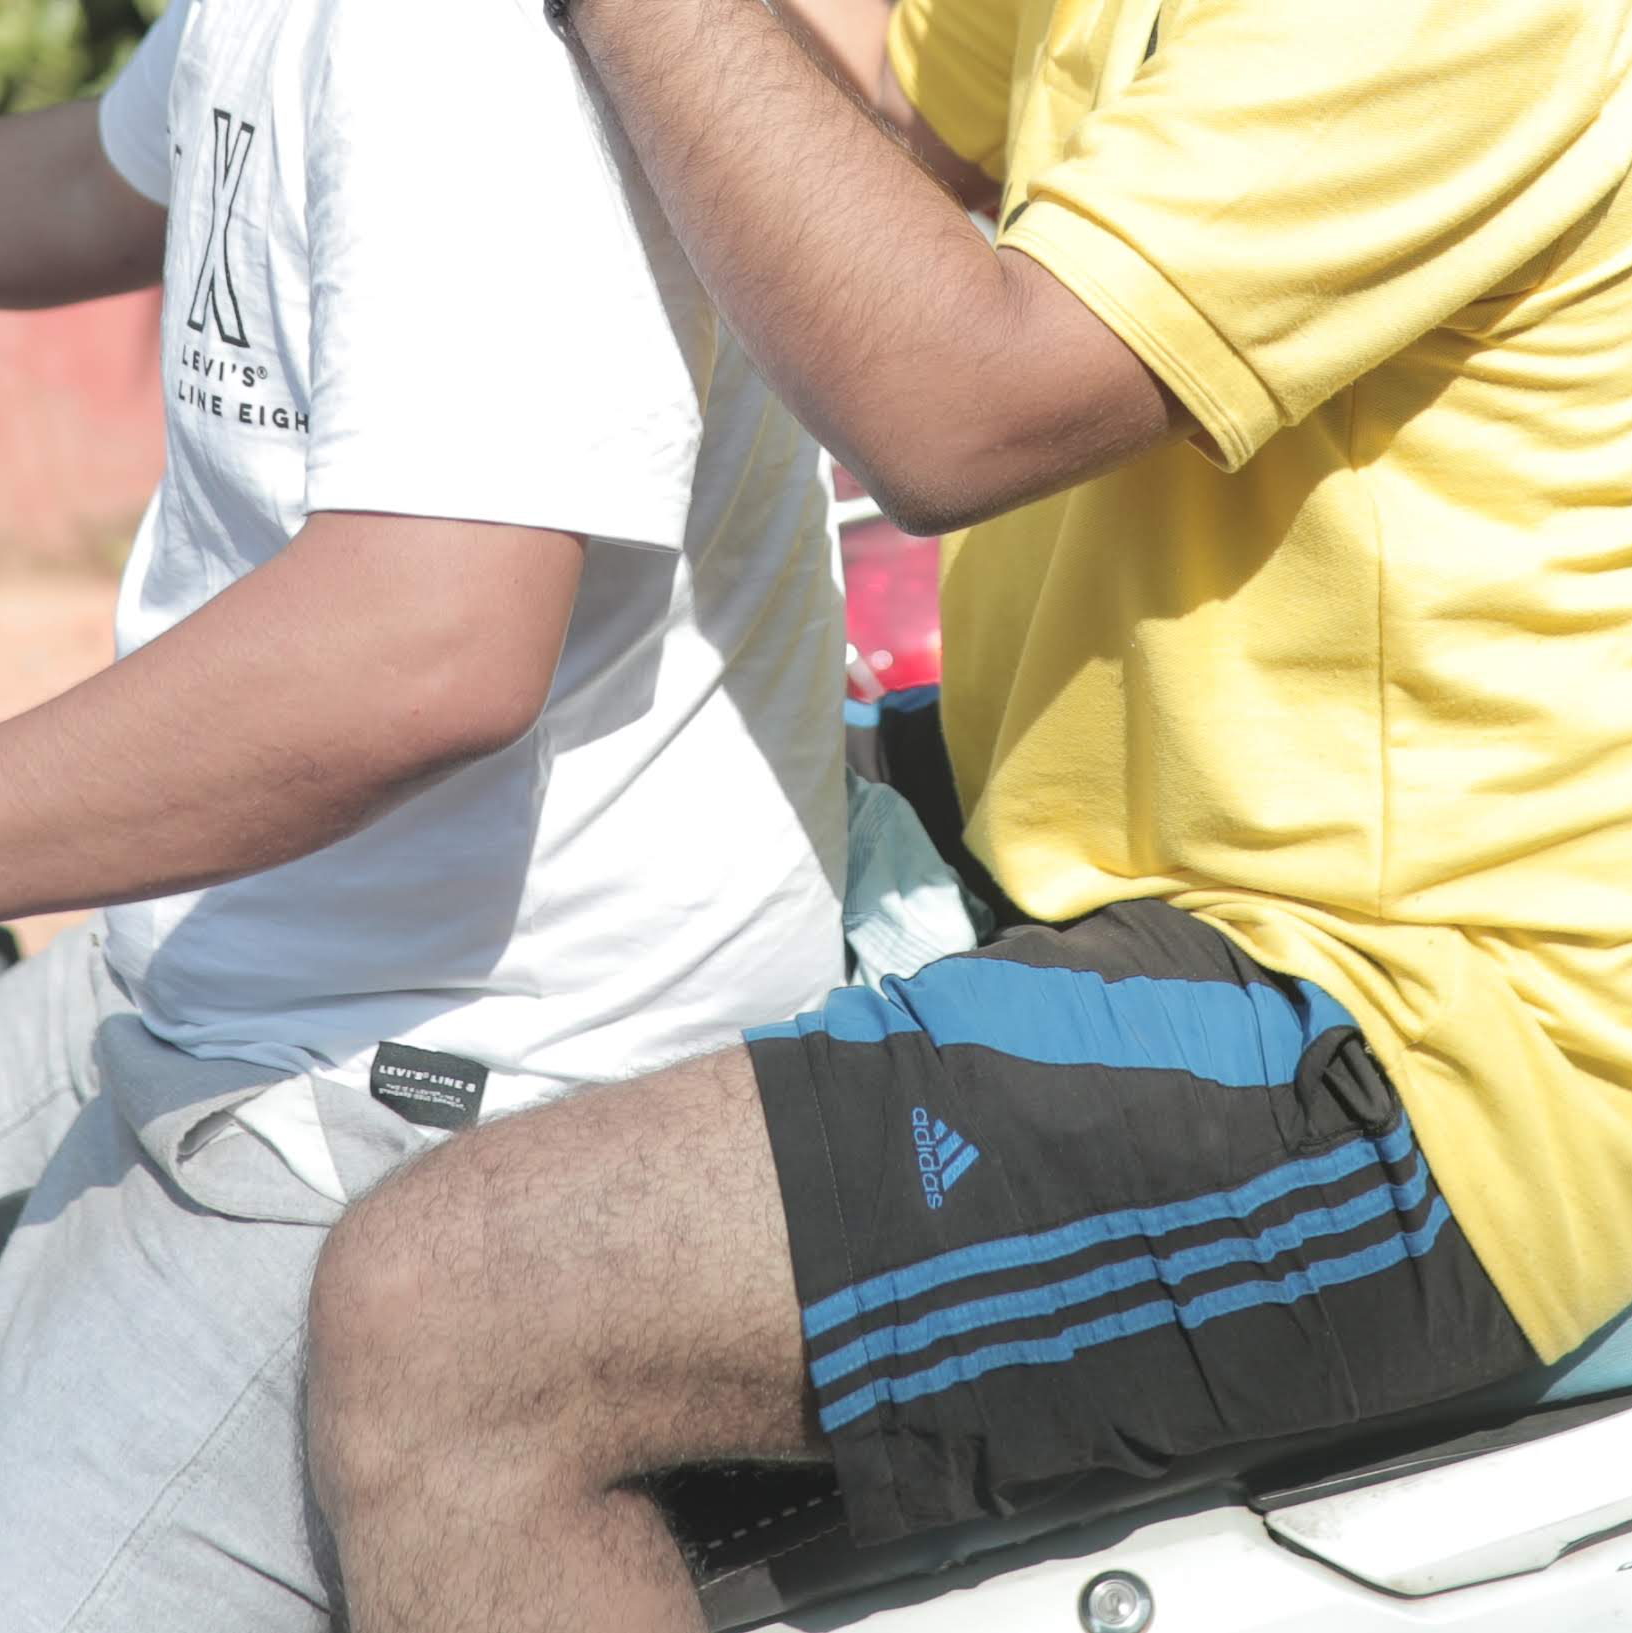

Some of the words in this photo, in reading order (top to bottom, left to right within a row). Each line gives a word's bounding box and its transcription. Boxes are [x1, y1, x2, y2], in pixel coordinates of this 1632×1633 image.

[178, 379, 223, 417] LINE
[430, 1074, 464, 1090] LINE
[465, 1082, 477, 1093] 8
[912, 1107, 944, 1210] adidas
